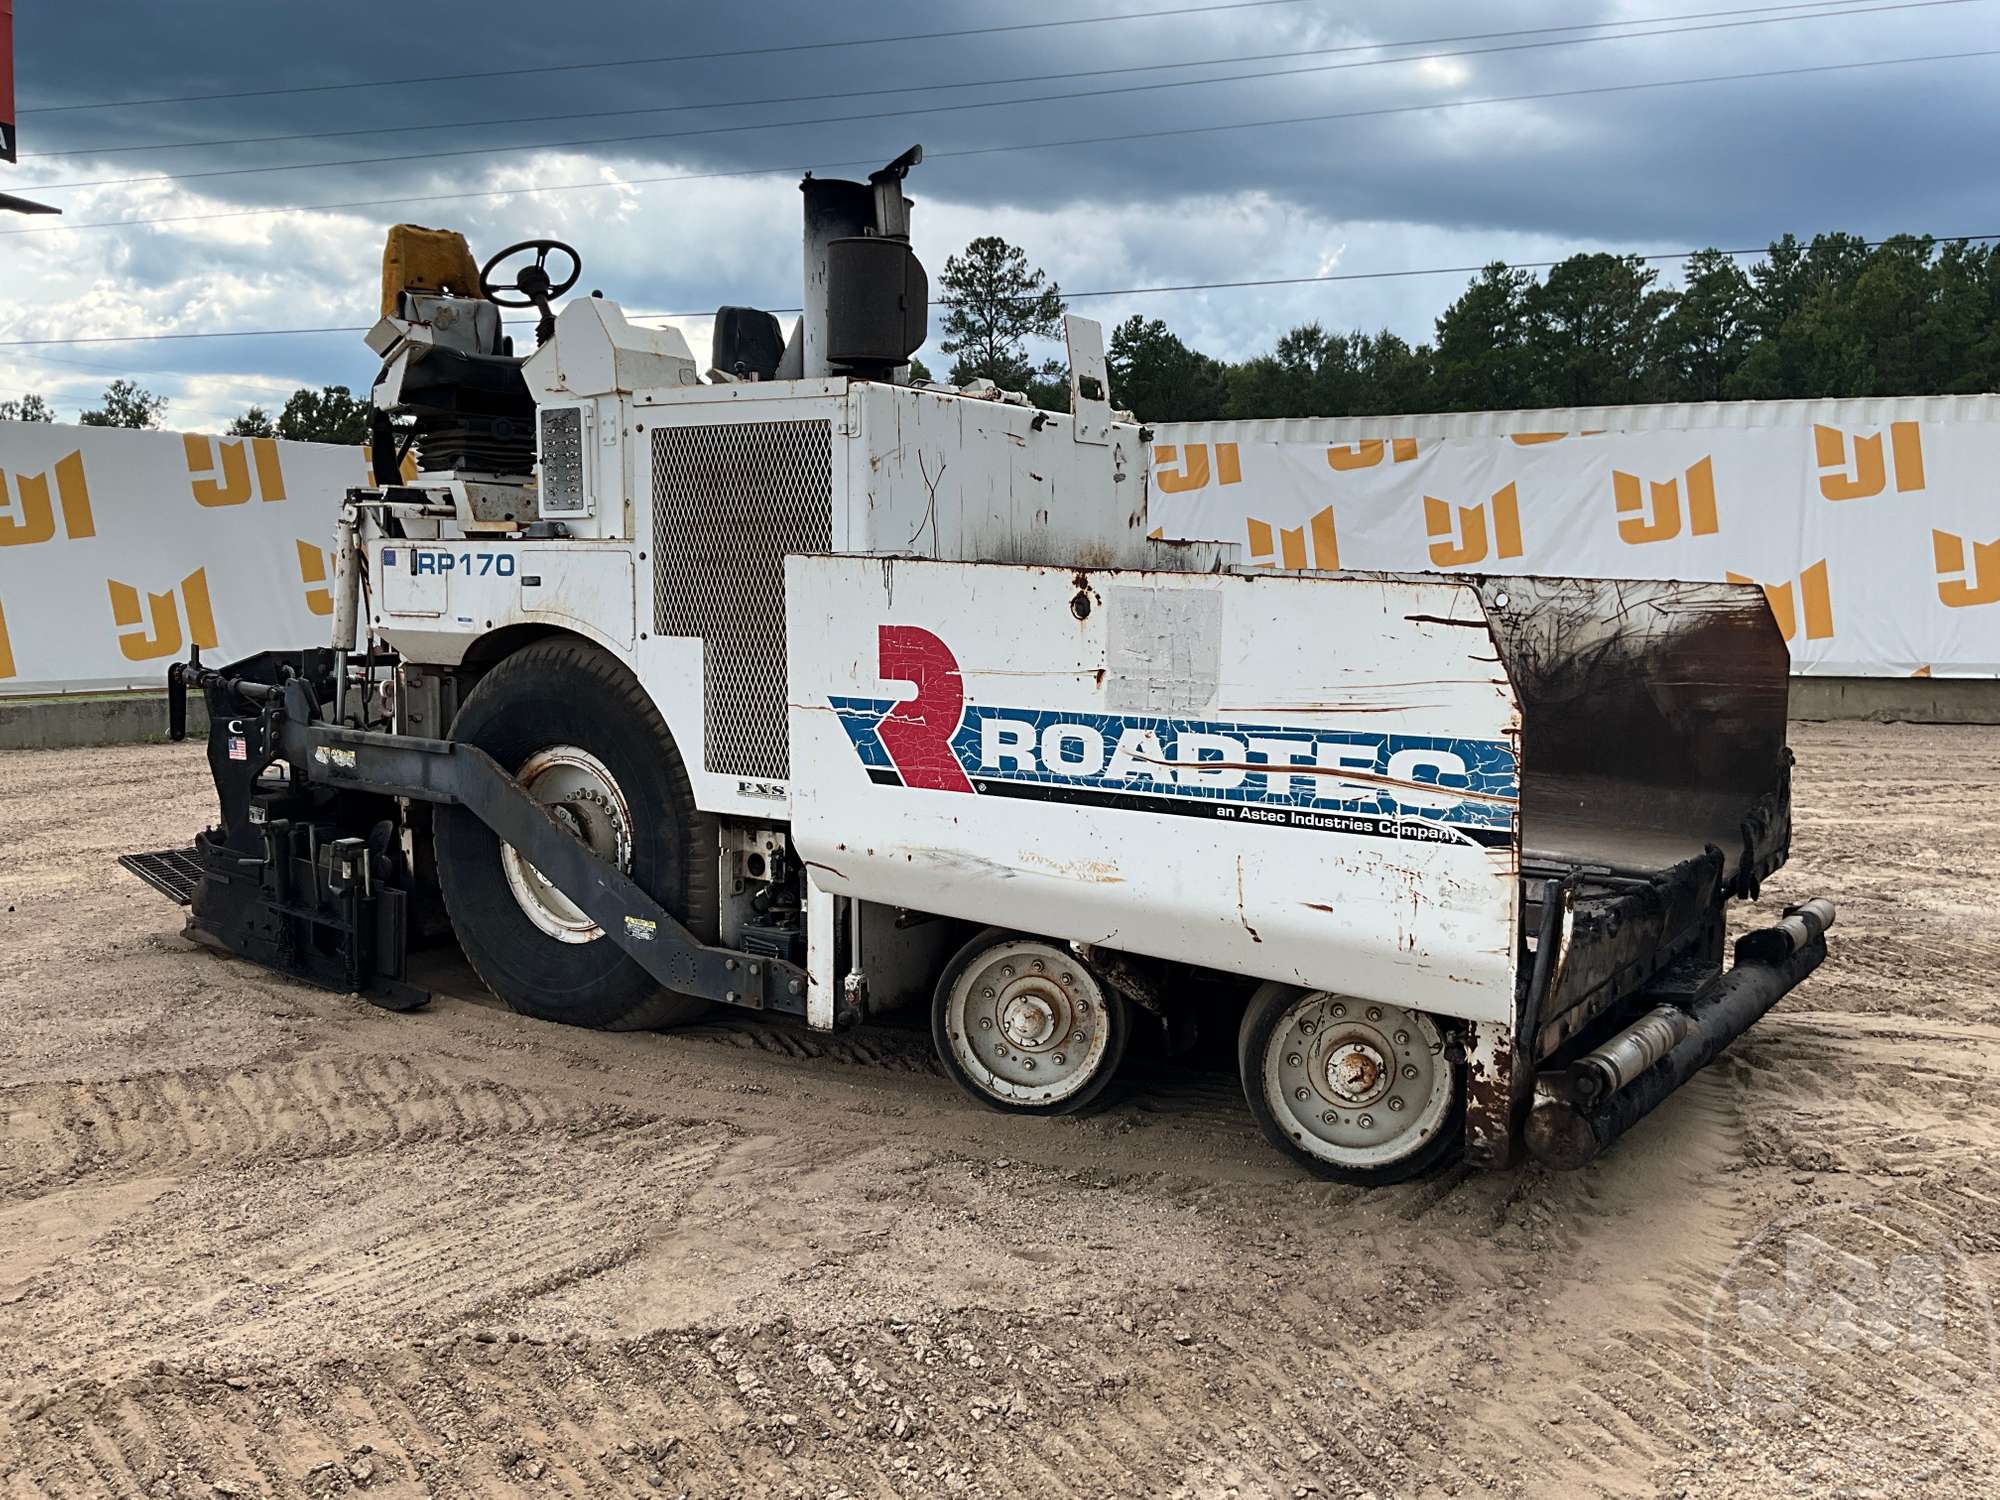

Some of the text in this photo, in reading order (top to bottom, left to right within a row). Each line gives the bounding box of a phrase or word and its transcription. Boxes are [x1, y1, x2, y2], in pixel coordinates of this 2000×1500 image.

[418, 552, 516, 577] RP170
[980, 718, 1466, 809] ROADTEC
[1216, 806, 1459, 844] an Astec Industries Company
